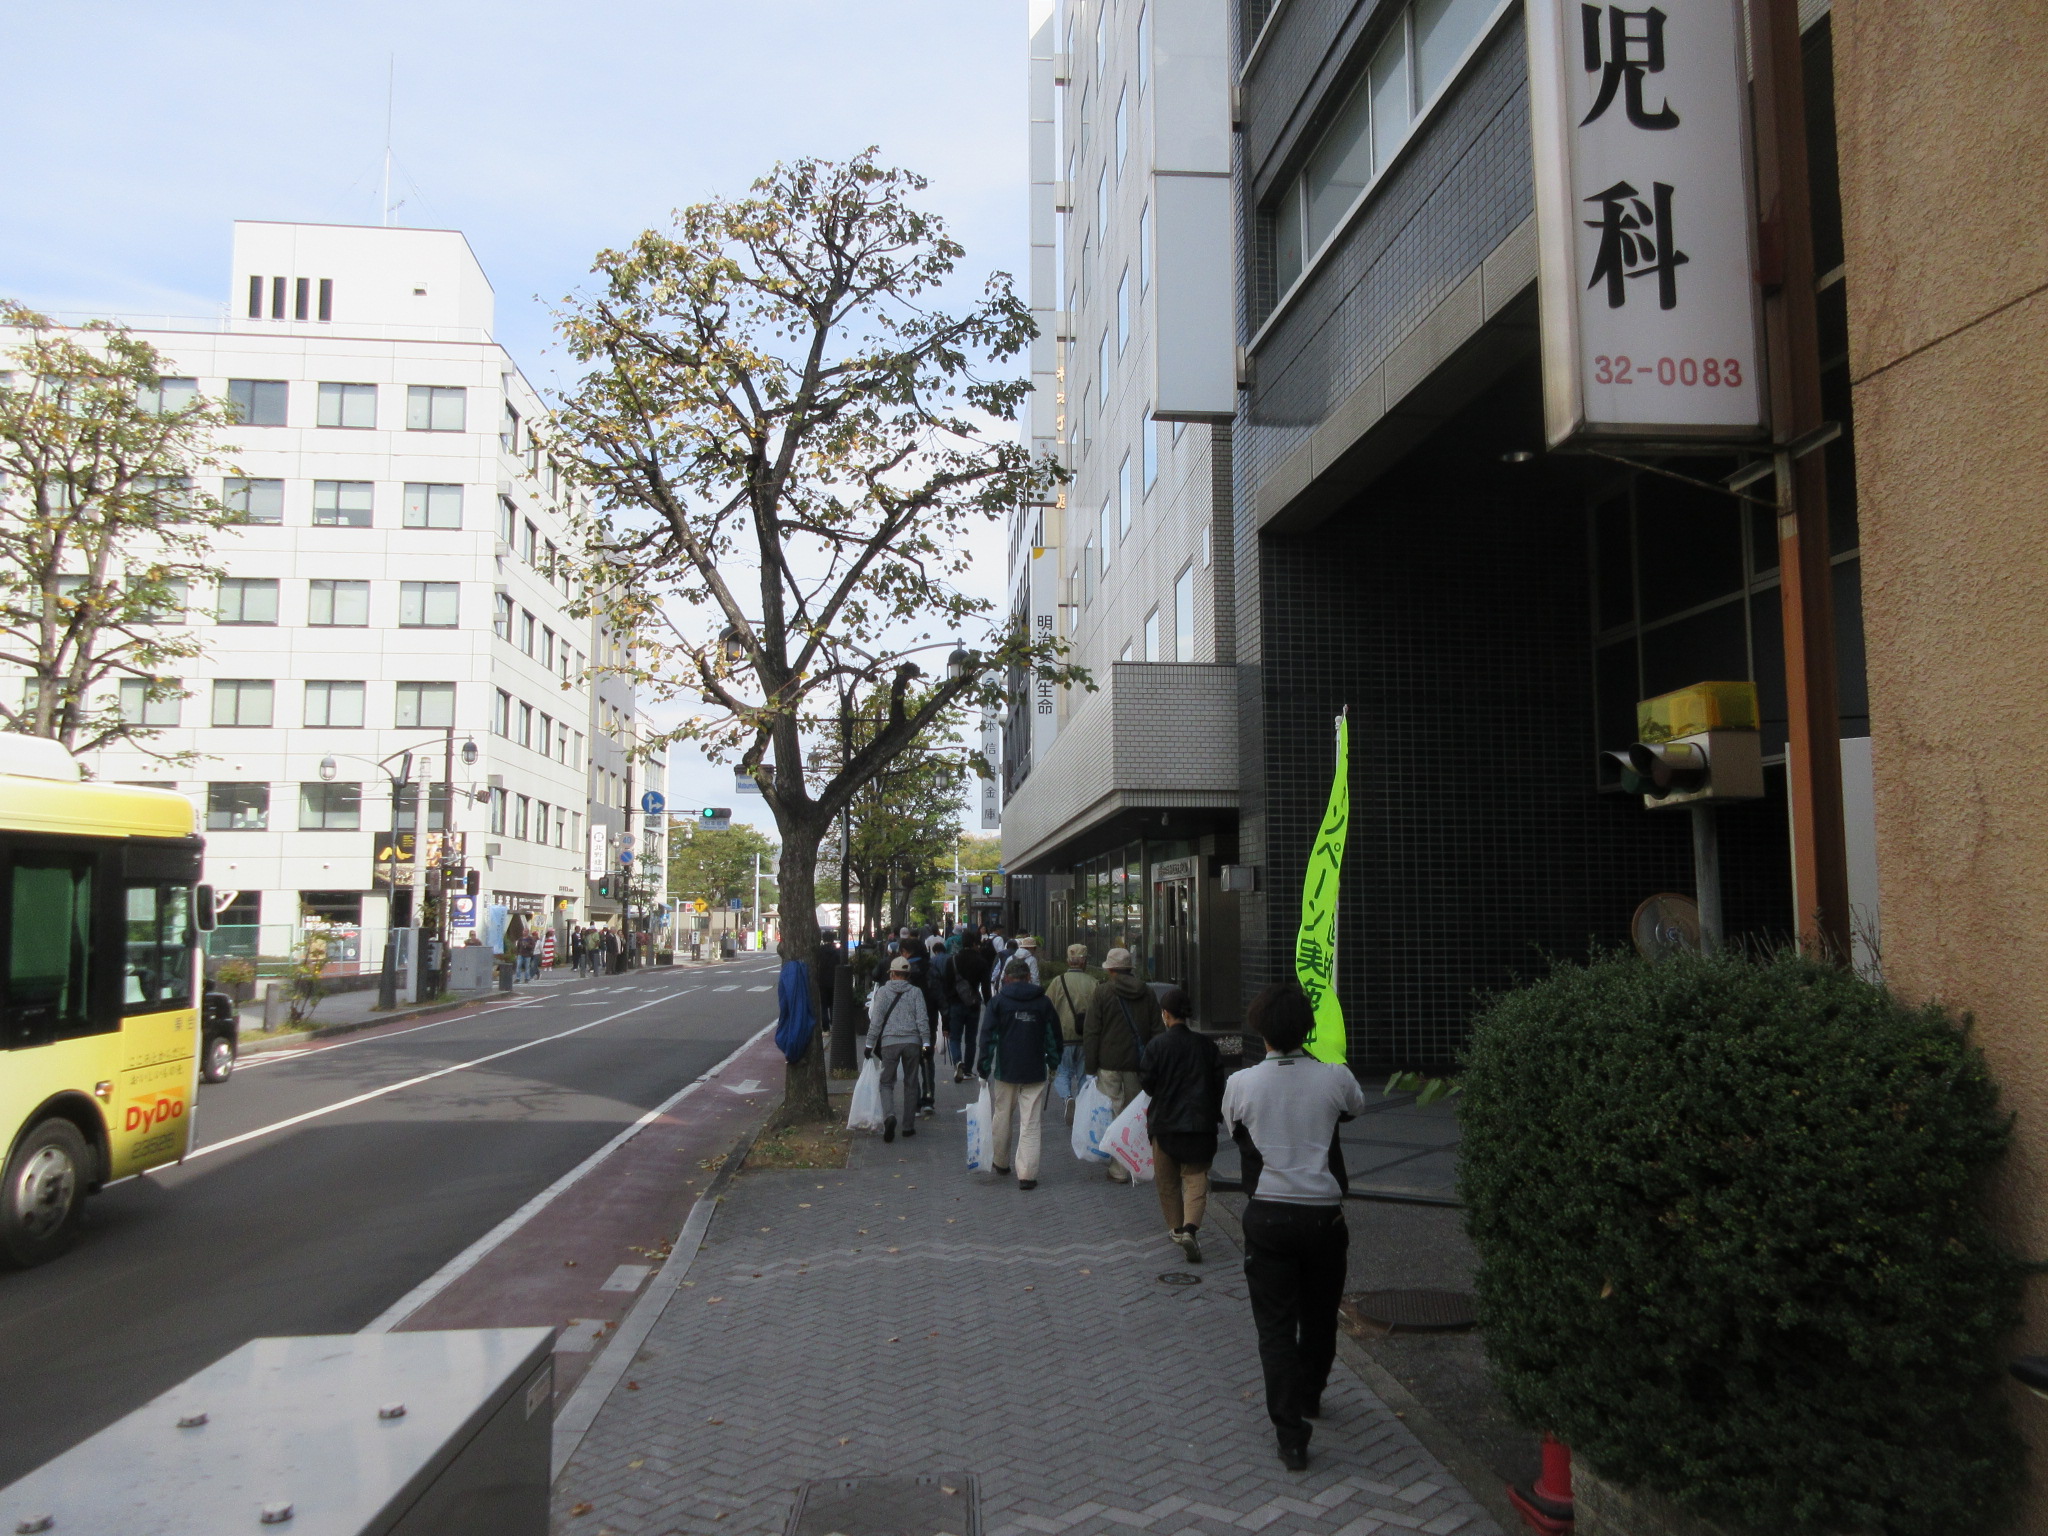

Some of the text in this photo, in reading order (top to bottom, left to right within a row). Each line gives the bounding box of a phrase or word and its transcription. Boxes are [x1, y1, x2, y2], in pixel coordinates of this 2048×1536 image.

[1578, 2, 1690, 311] 児科
[1594, 355, 1743, 388] 32-0083
[622, 836, 632, 844] 40
[125, 1098, 184, 1134] DyDo
